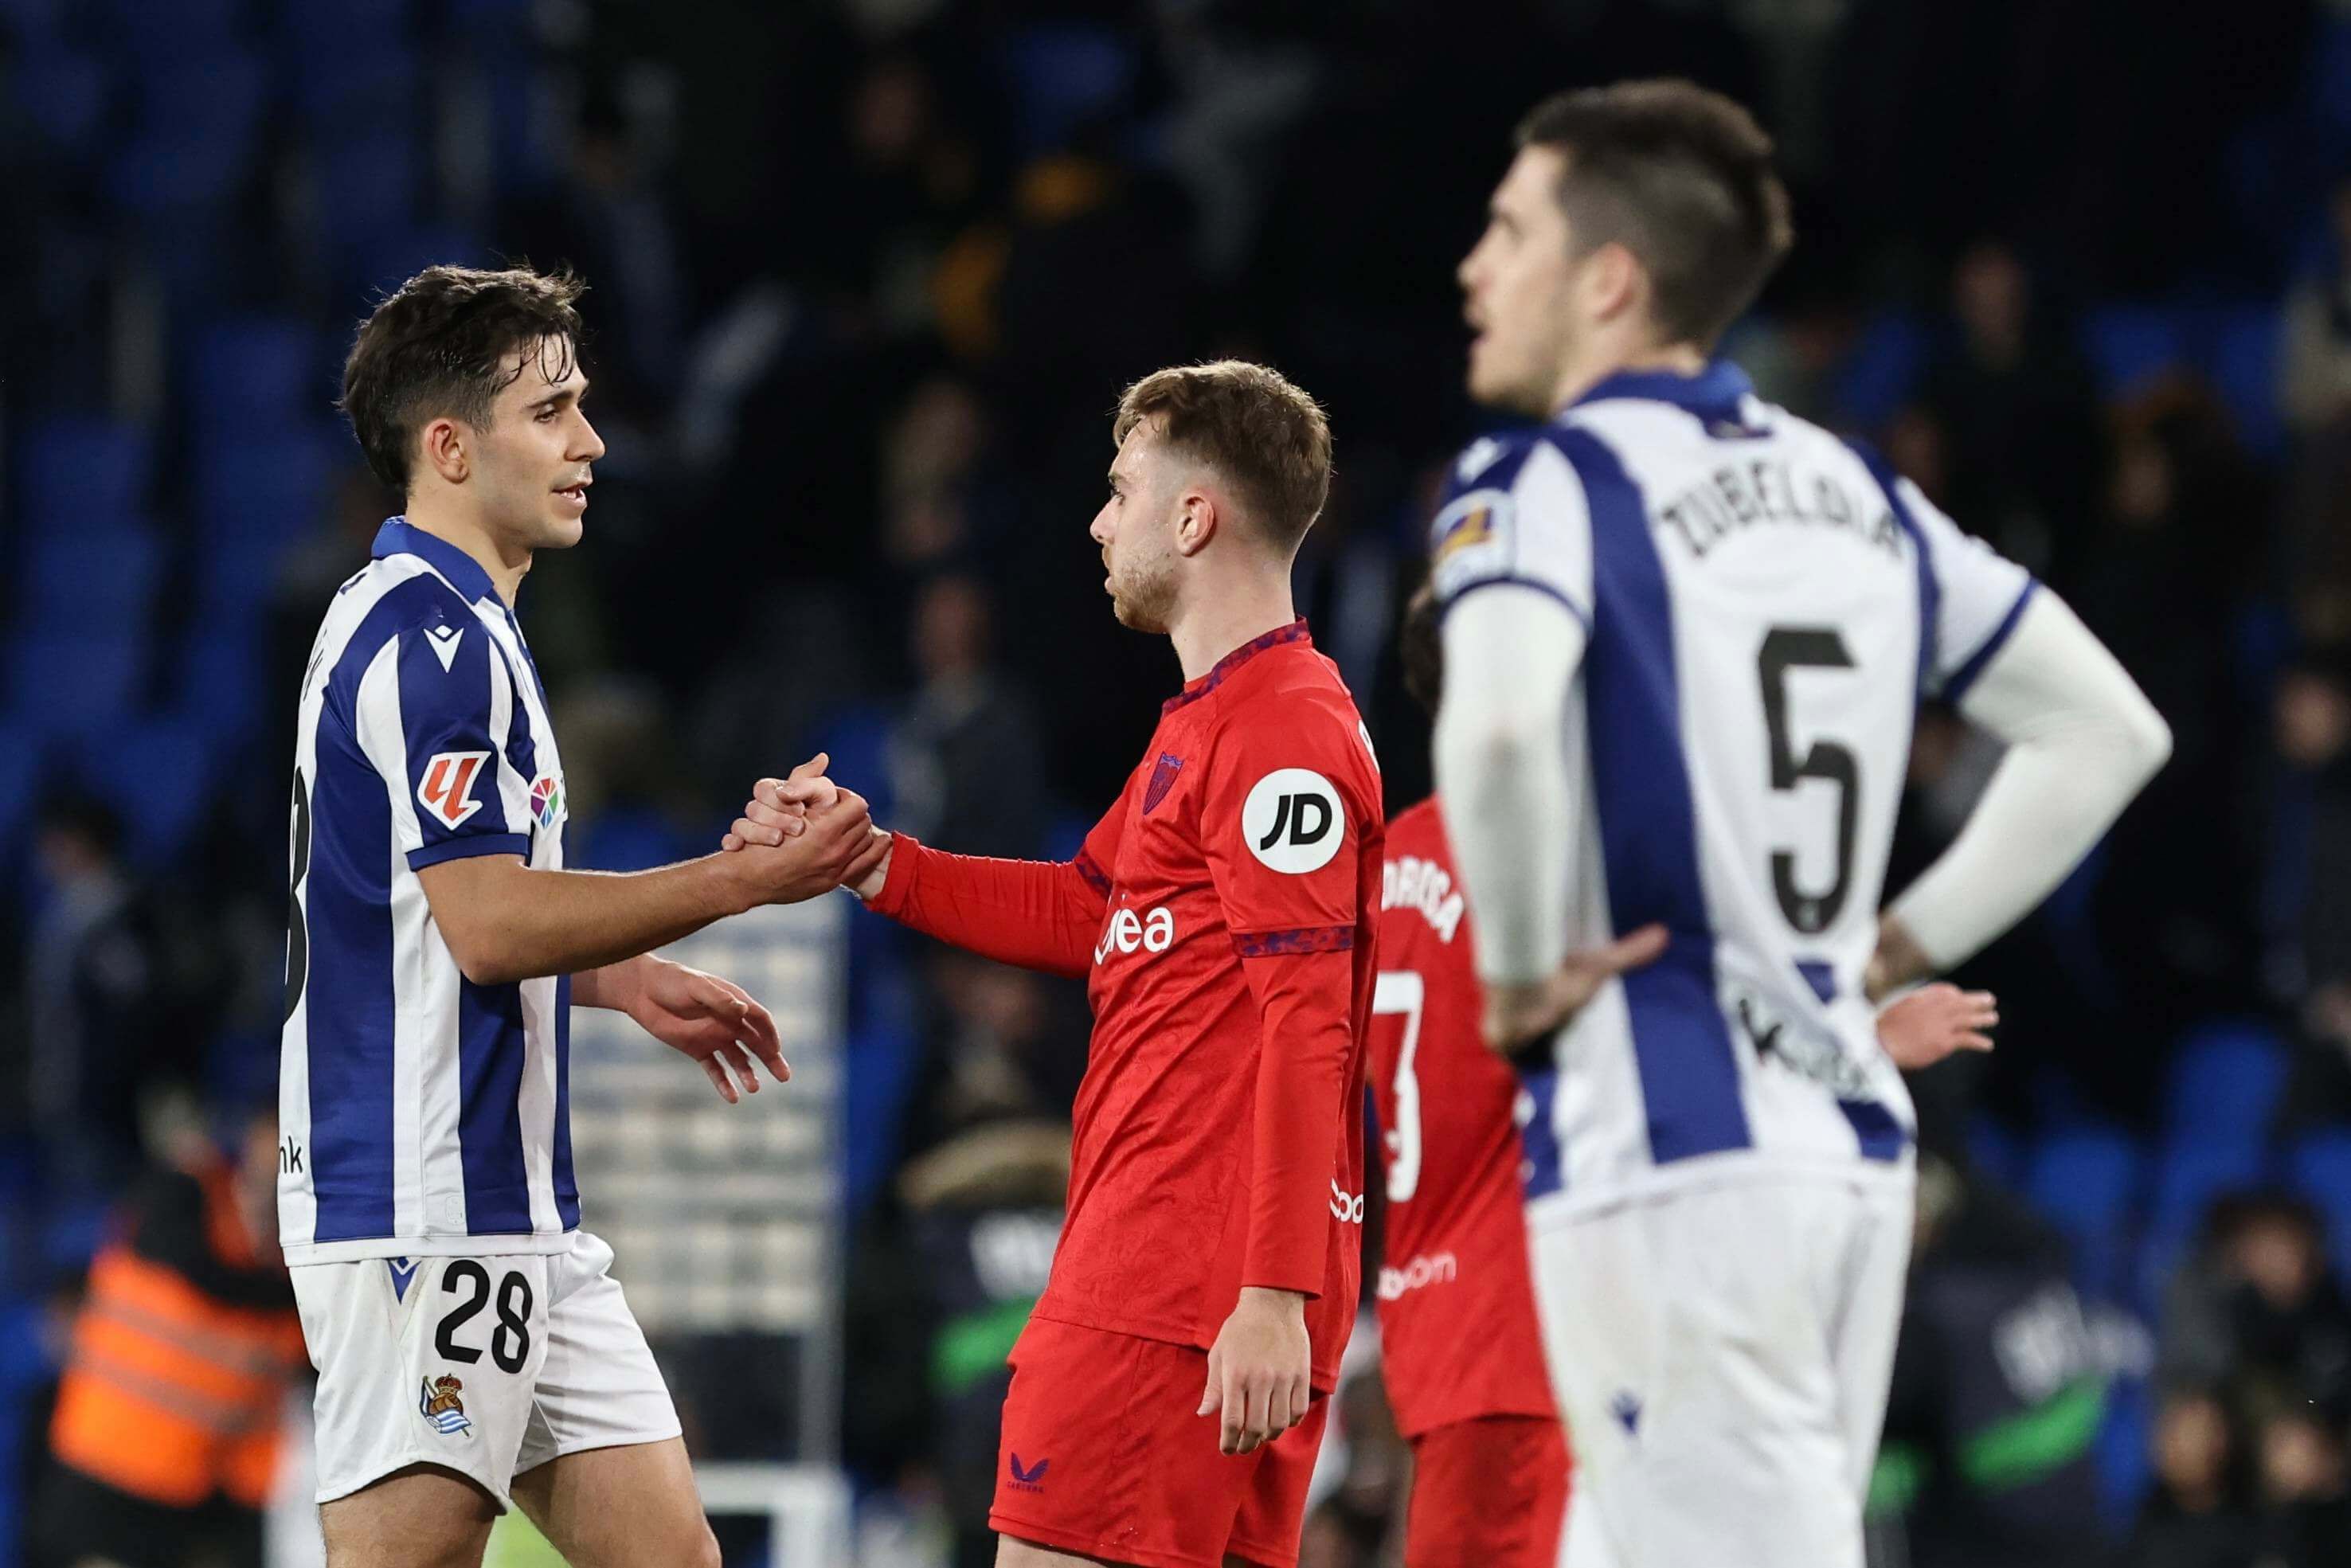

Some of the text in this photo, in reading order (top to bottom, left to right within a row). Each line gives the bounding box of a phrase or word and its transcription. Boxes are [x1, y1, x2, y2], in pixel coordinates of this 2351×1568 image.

[1260, 793, 1332, 851] JD
[1758, 627, 1856, 934] 5
[1381, 856, 1464, 944] DROSA
[280, 1135, 303, 1175] nk
[435, 1259, 533, 1374] 28
